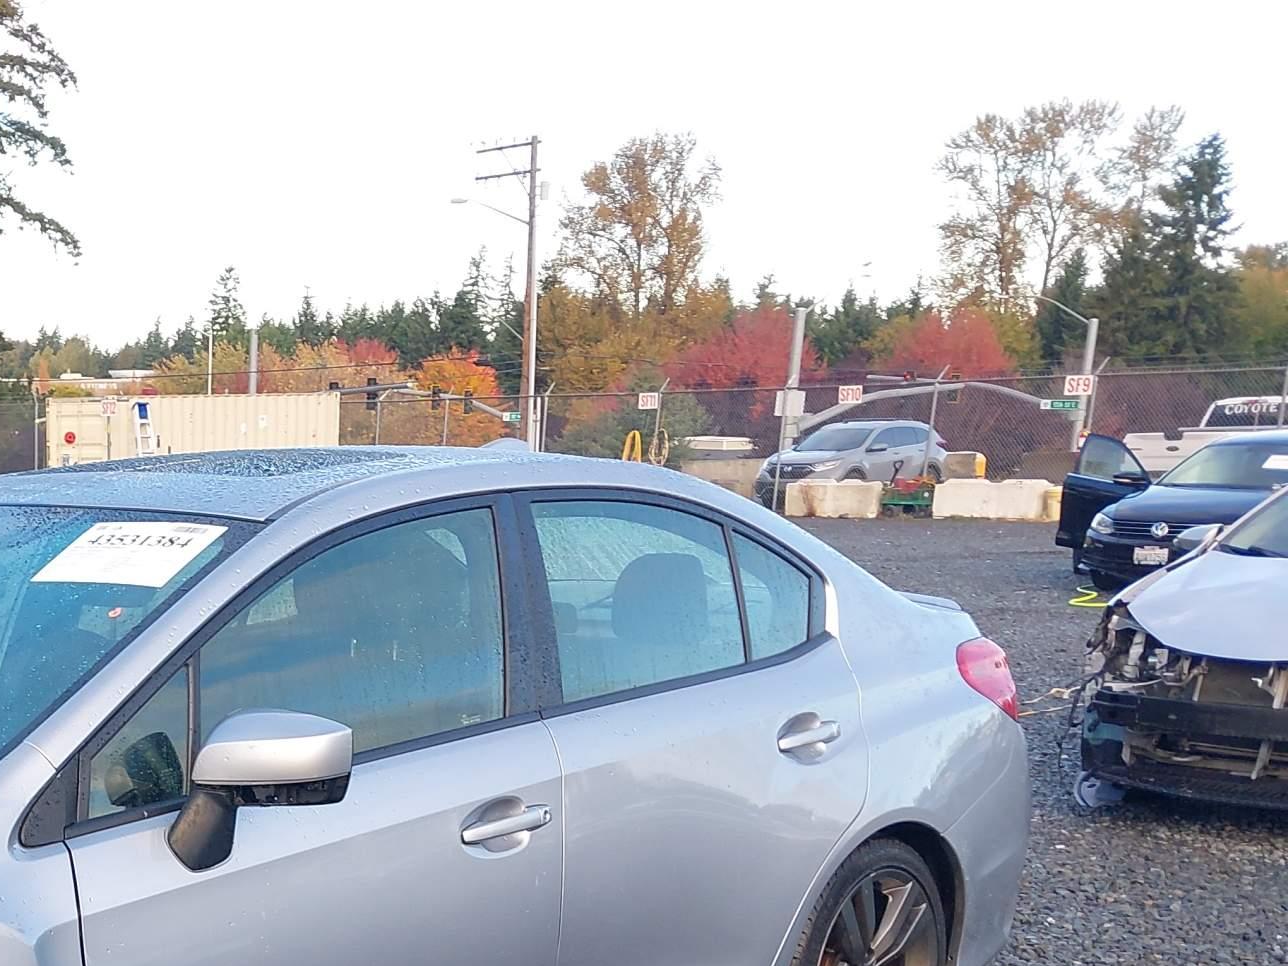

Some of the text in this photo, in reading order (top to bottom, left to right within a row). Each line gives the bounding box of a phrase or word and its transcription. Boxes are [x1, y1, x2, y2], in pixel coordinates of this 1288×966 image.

[1067, 377, 1091, 393] SF9
[640, 394, 657, 408] SF11
[840, 387, 861, 402] SF10
[1224, 402, 1279, 415] COYOTE
[88, 534, 195, 549] 43531384
